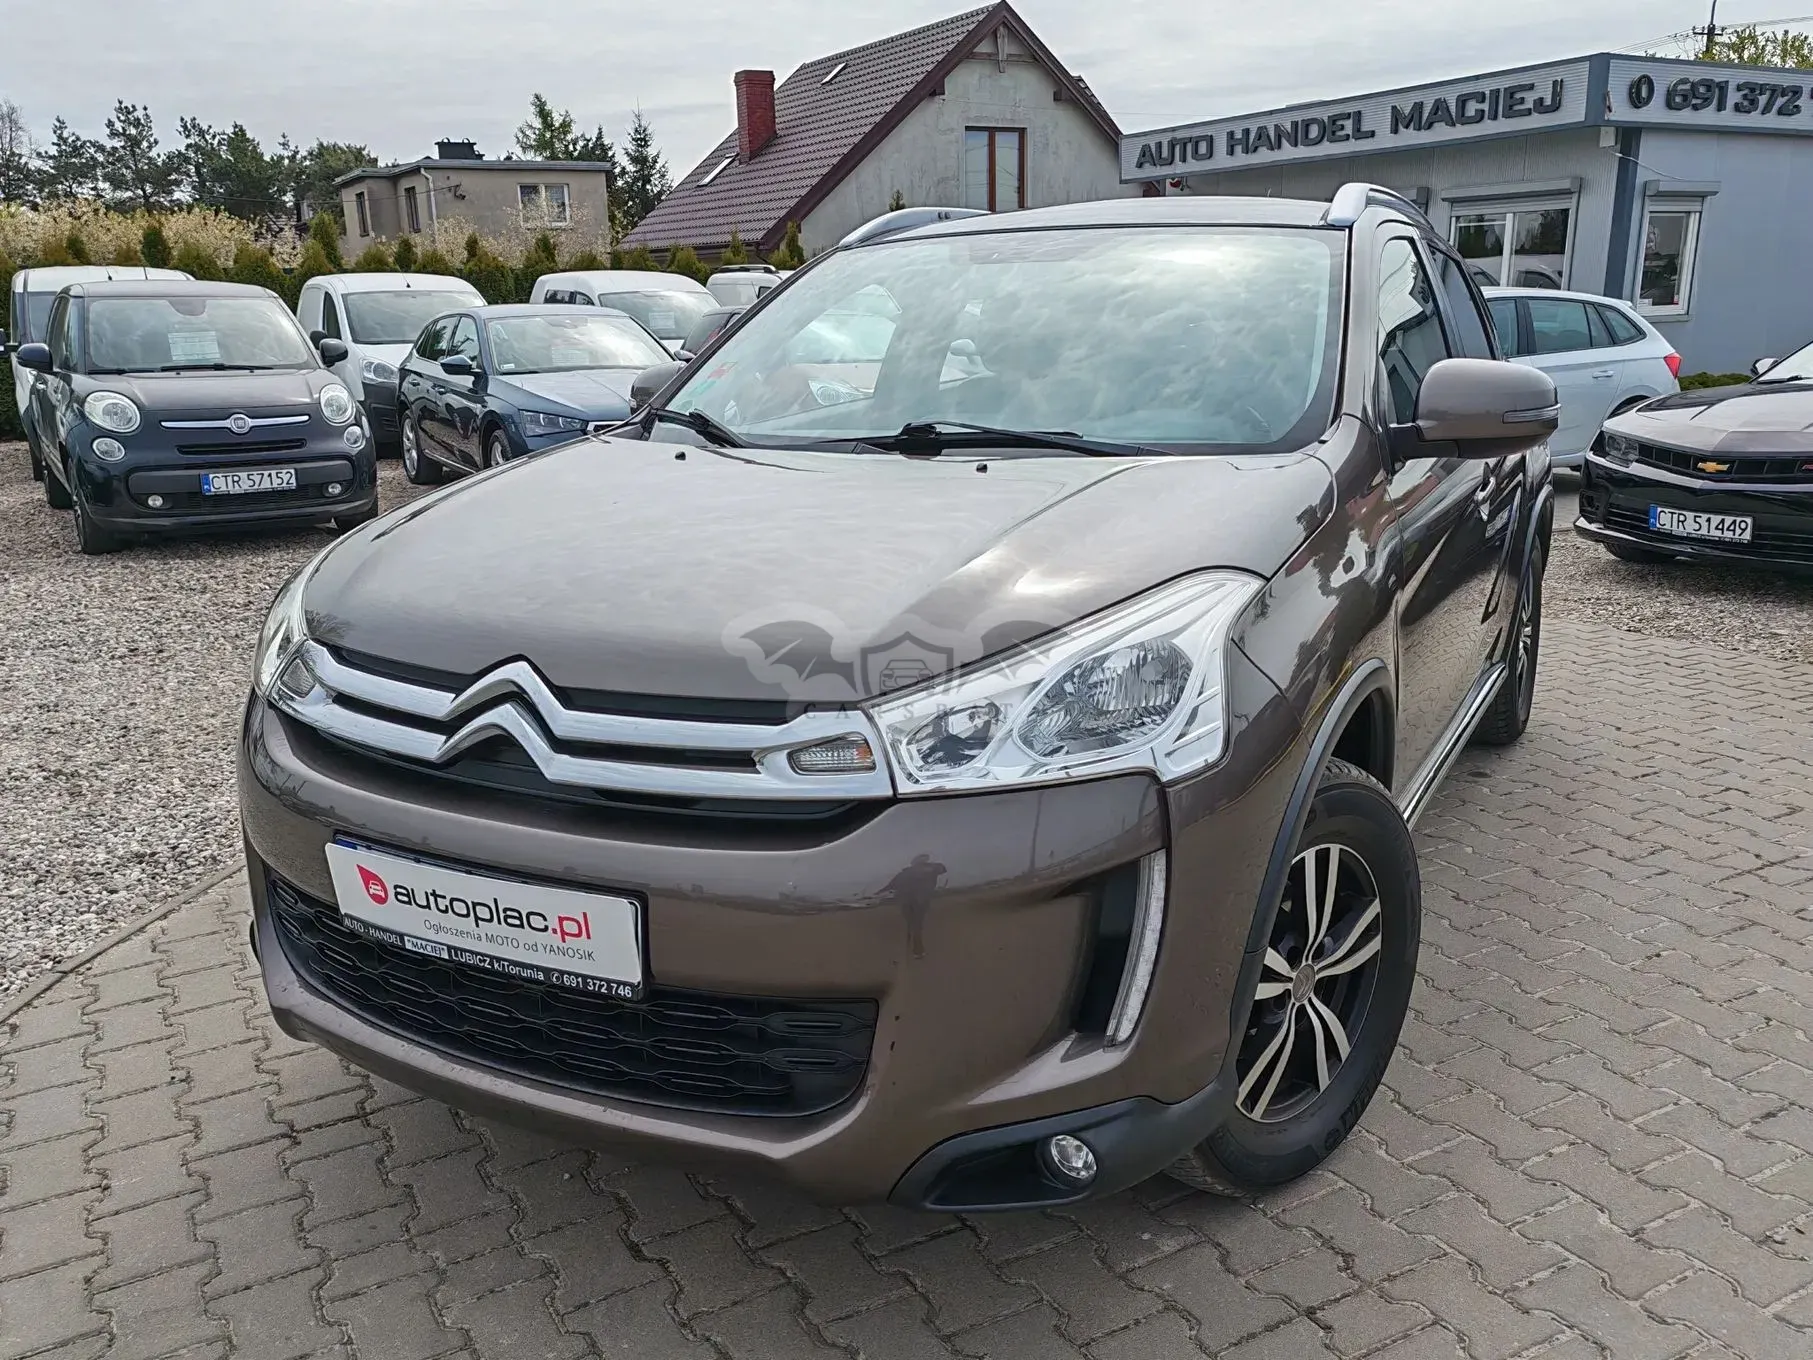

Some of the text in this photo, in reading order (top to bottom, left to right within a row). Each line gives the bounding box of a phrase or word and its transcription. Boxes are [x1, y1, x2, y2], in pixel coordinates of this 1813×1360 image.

[1666, 77, 1729, 112] 691
[1734, 81, 1804, 116] 372
[1135, 78, 1564, 168] AUTO HANDEL MACIEJ
[211, 474, 242, 490] CTR
[246, 471, 294, 488] 57152
[1657, 510, 1687, 530] CTR
[1693, 515, 1749, 537] 51449
[393, 883, 592, 943] autoplac.pl
[344, 916, 364, 933] AUTO
[369, 928, 403, 946] HANDEL
[451, 949, 492, 968] LUBICZ
[494, 960, 545, 981] k/Torunia
[563, 974, 583, 988] 691
[587, 979, 608, 993] 372
[611, 983, 632, 998] 746
[423, 919, 597, 962] Ogłoszenia MOTO od YANOSIK
